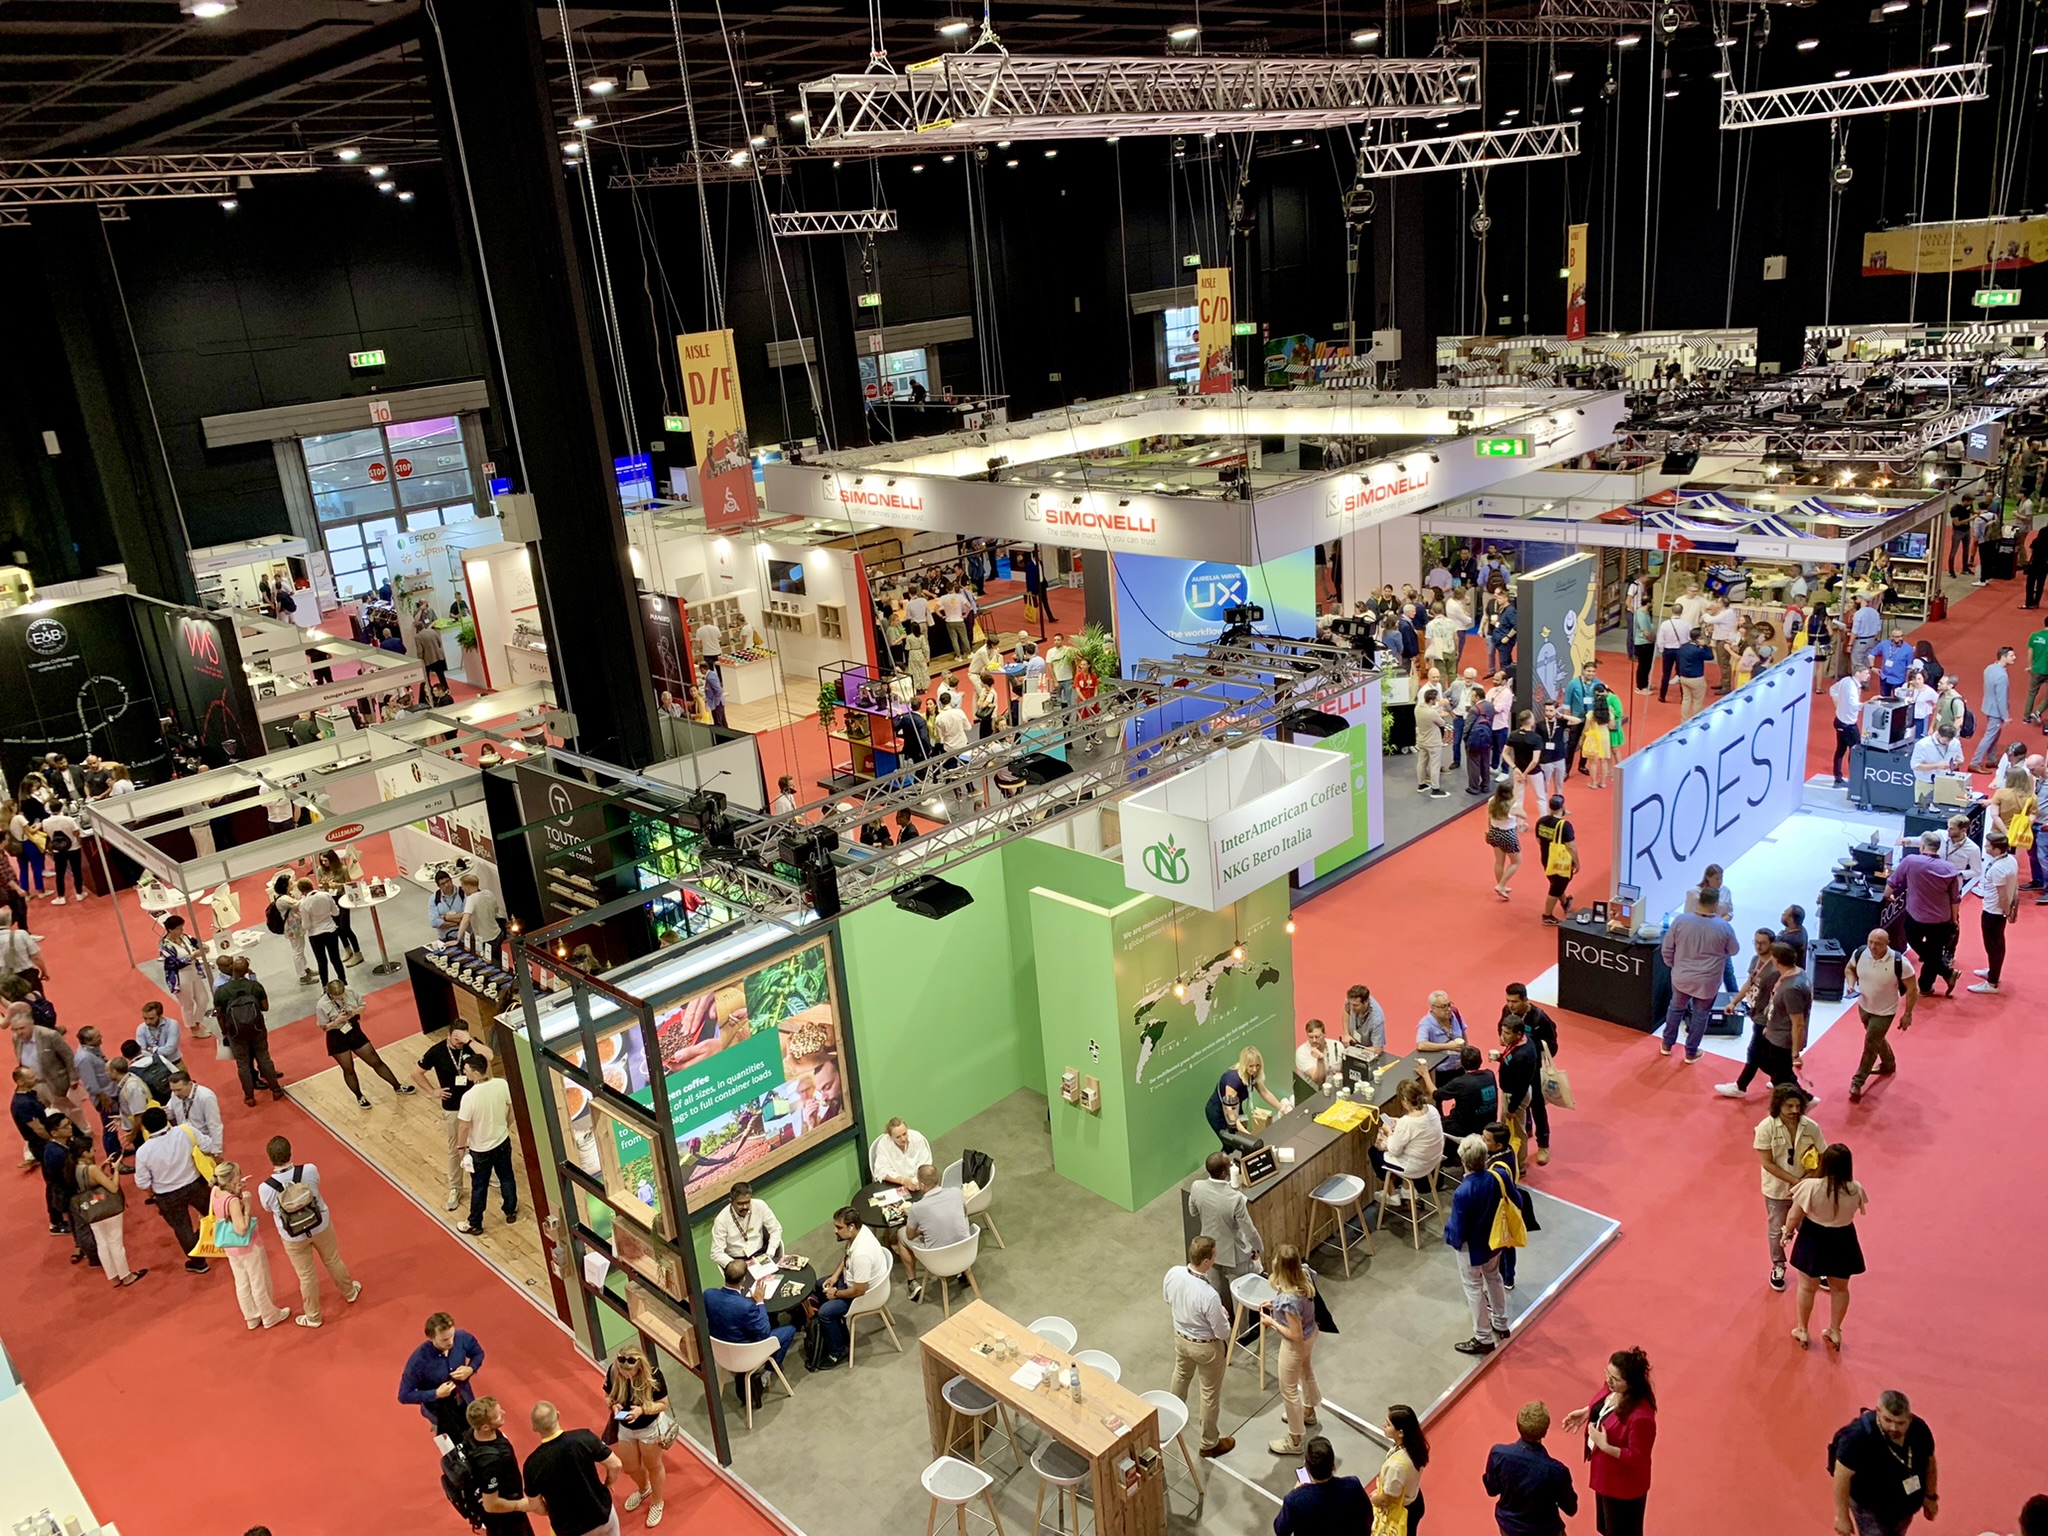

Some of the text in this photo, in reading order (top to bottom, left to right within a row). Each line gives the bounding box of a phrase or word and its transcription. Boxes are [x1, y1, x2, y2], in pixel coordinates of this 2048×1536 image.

[1201, 277, 1216, 289] AISLE
[1200, 296, 1229, 324] C/D
[685, 344, 711, 360] AISLE
[374, 408, 390, 420] 10
[368, 467, 387, 478] STOP
[395, 462, 413, 474] STOP
[839, 489, 924, 511] SIMONELLI
[1344, 471, 1429, 512] SIMONELLI
[1045, 509, 1156, 533] SIMONELLI
[408, 532, 437, 545] EFICO
[1047, 527, 1059, 536] The
[1060, 529, 1081, 539] coffee
[1112, 534, 1126, 544] you
[1126, 536, 1139, 544] can
[1191, 572, 1241, 583] AURELIA WAVE
[1191, 580, 1243, 609] UX
[1628, 692, 1807, 886] ROEST
[1863, 767, 1914, 787] ROES
[1220, 781, 1349, 855] InterAmerican Coffee
[327, 824, 364, 842] LALLEMAND
[1222, 827, 1313, 884] NKG Bero Italia
[1880, 889, 1908, 926] ROES
[1122, 929, 1133, 941] We
[1132, 925, 1143, 936] are
[1142, 912, 1168, 931] members
[1128, 934, 1145, 951] global
[1145, 924, 1166, 941] network
[1565, 940, 1645, 976] ROEST
[673, 1099, 684, 1112] of
[683, 1095, 695, 1107] all
[695, 1086, 717, 1101] sizes,
[717, 1079, 726, 1089] in
[726, 1060, 766, 1086] quantities
[682, 1074, 711, 1093] coffee
[620, 1135, 643, 1150] from
[689, 1103, 700, 1115] to
[699, 1096, 715, 1111] full
[714, 1079, 751, 1104] container
[751, 1068, 773, 1085] loads
